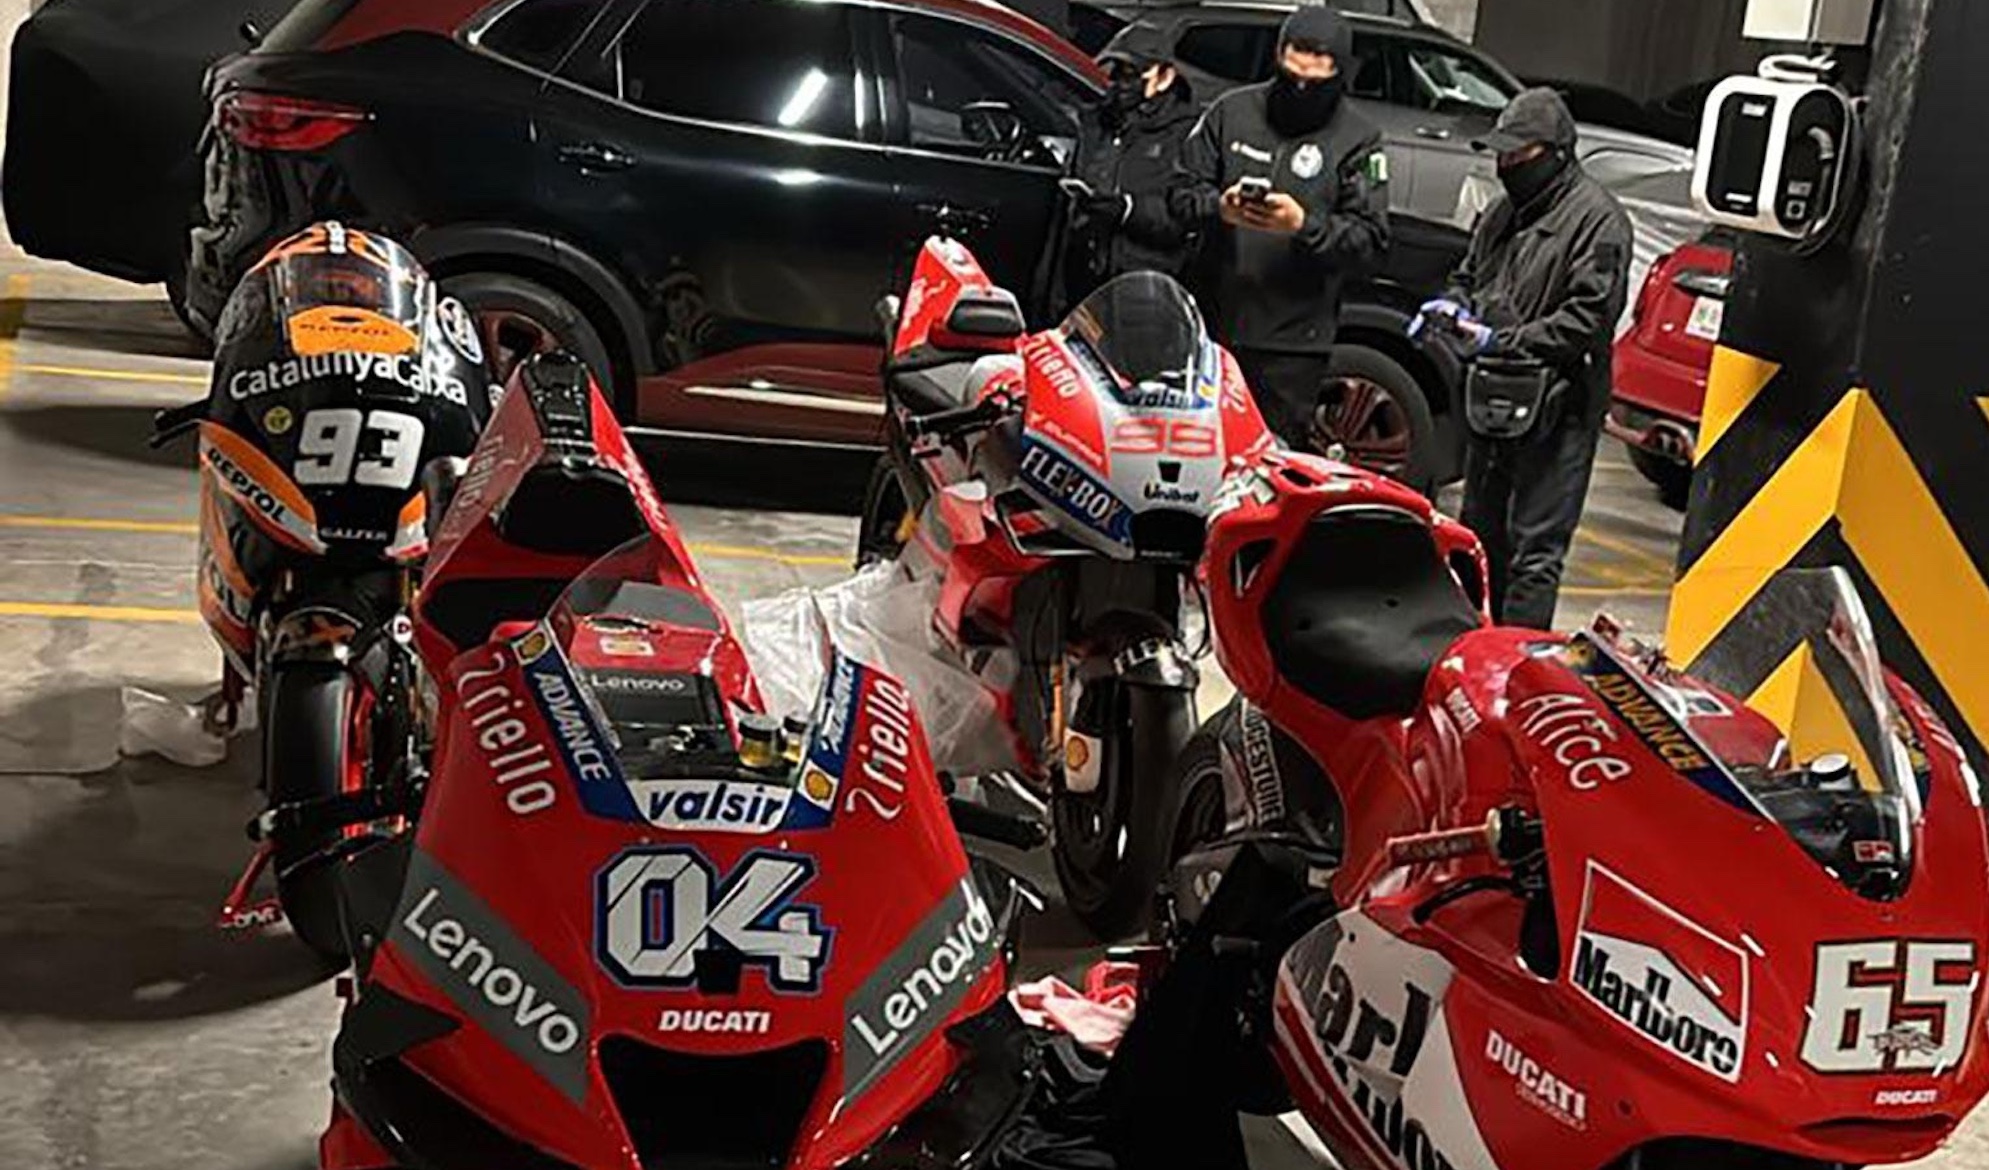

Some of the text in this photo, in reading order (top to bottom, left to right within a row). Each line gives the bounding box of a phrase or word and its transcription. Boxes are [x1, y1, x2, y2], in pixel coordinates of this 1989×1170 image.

[229, 350, 468, 405] CatalunyaCaixa
[293, 408, 425, 489] 93
[1110, 418, 1217, 457] 99
[533, 672, 612, 781] ADVANCE
[591, 674, 685, 691] Lenovo
[1582, 674, 1711, 770] ADVANCE
[649, 782, 784, 823] valsir
[602, 850, 830, 988] 04
[403, 887, 580, 1054] Lenovo
[1573, 934, 1738, 1074] Marlboro
[1801, 940, 1974, 1071] 65
[659, 1010, 771, 1034] DUCATI
[1485, 1029, 1586, 1120] DUCATI
